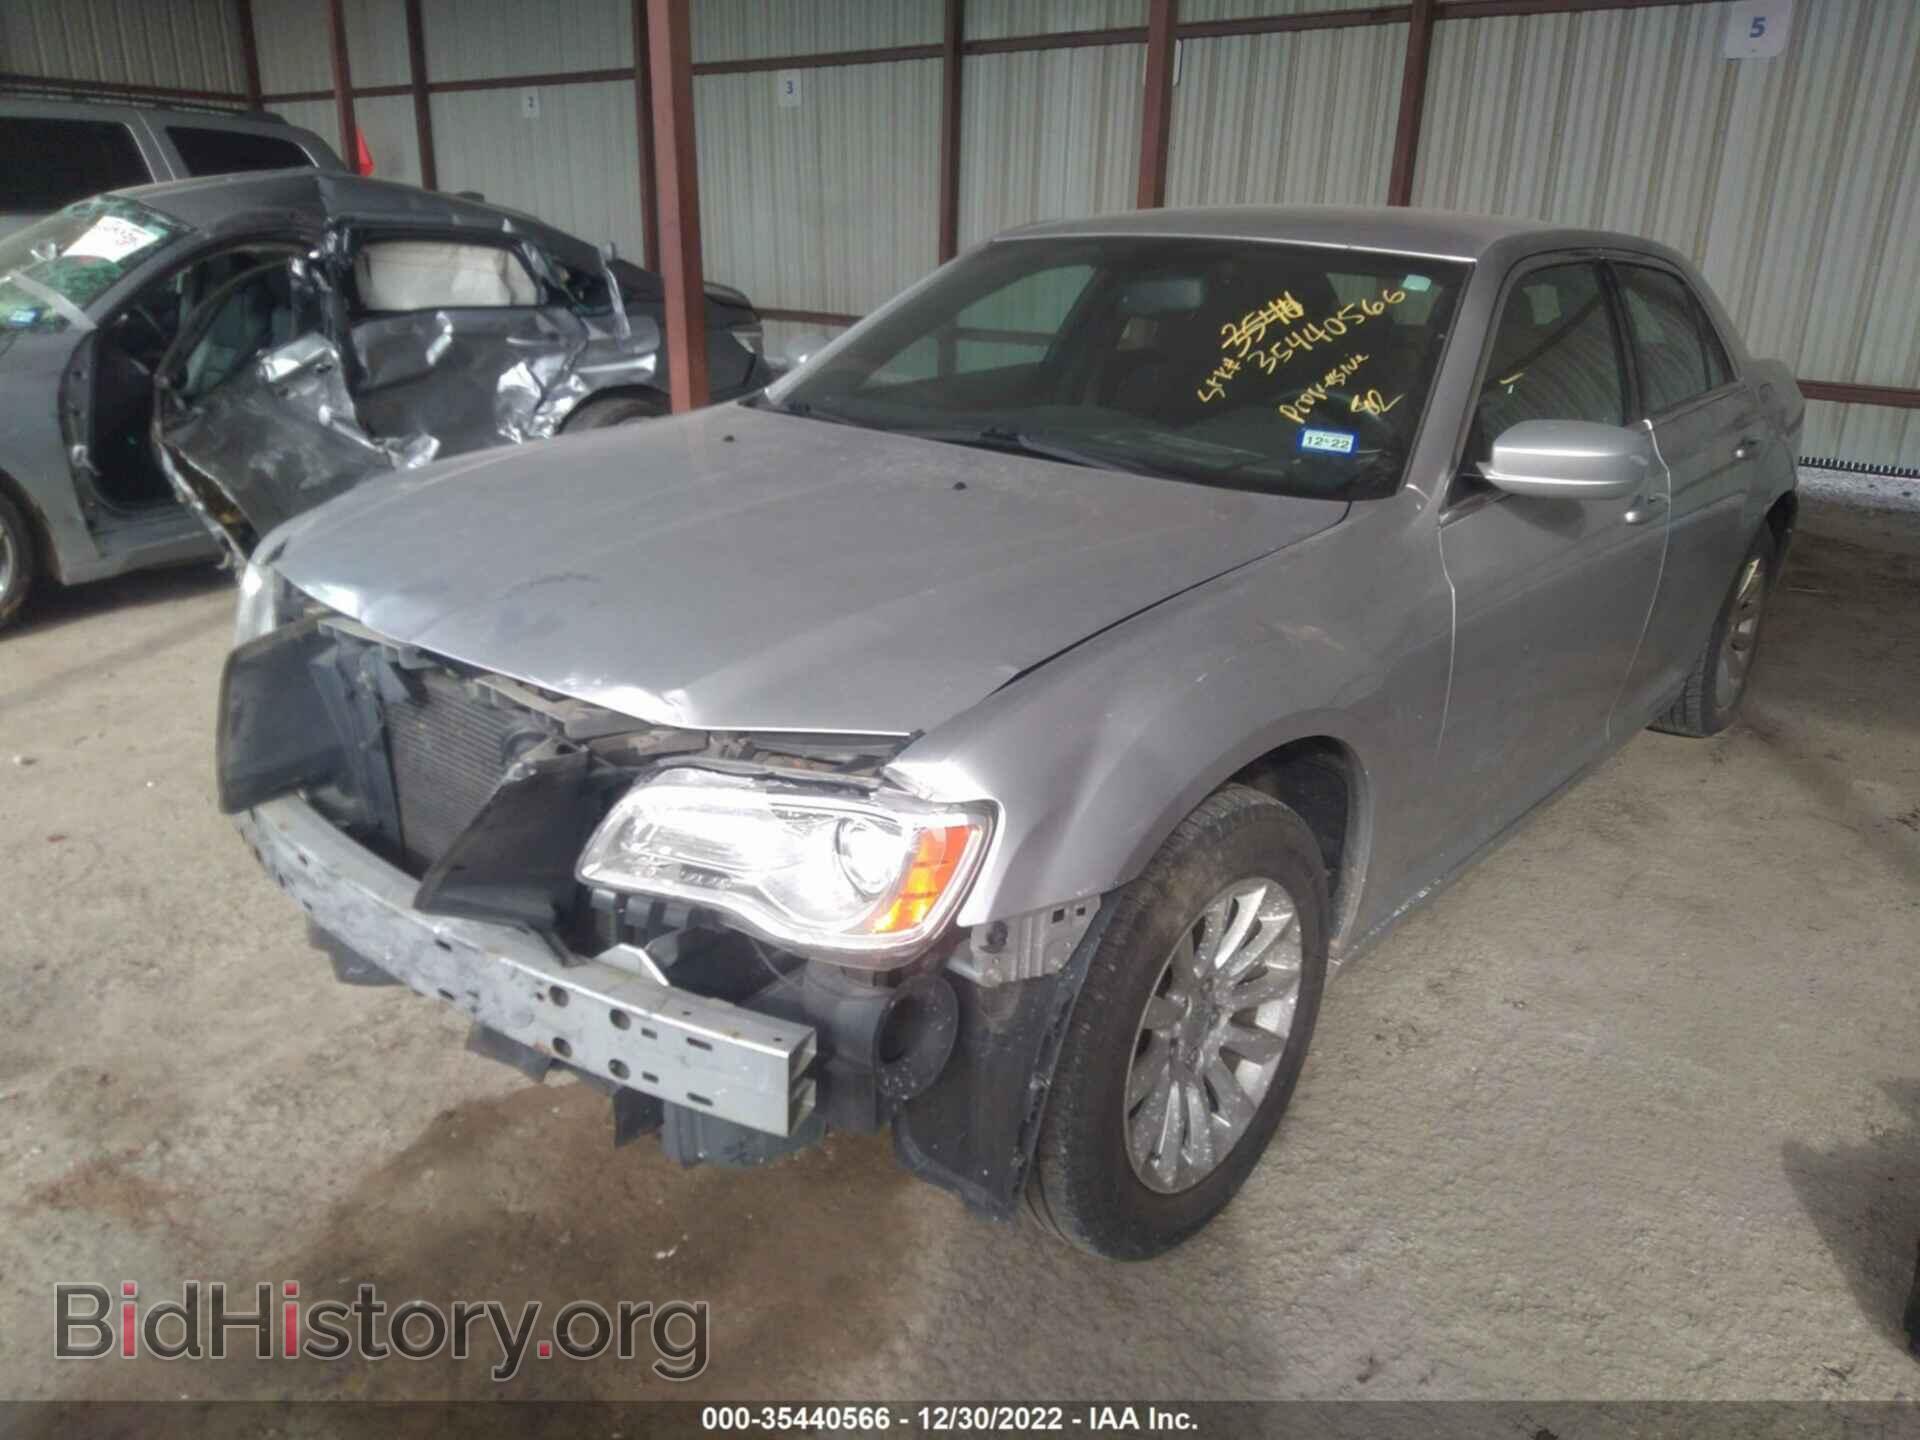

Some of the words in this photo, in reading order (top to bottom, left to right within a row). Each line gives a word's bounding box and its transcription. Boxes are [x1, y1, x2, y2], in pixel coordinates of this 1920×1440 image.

[1749, 16, 1767, 39] 5
[785, 80, 794, 95] 3
[1247, 289, 1406, 375] 35440566
